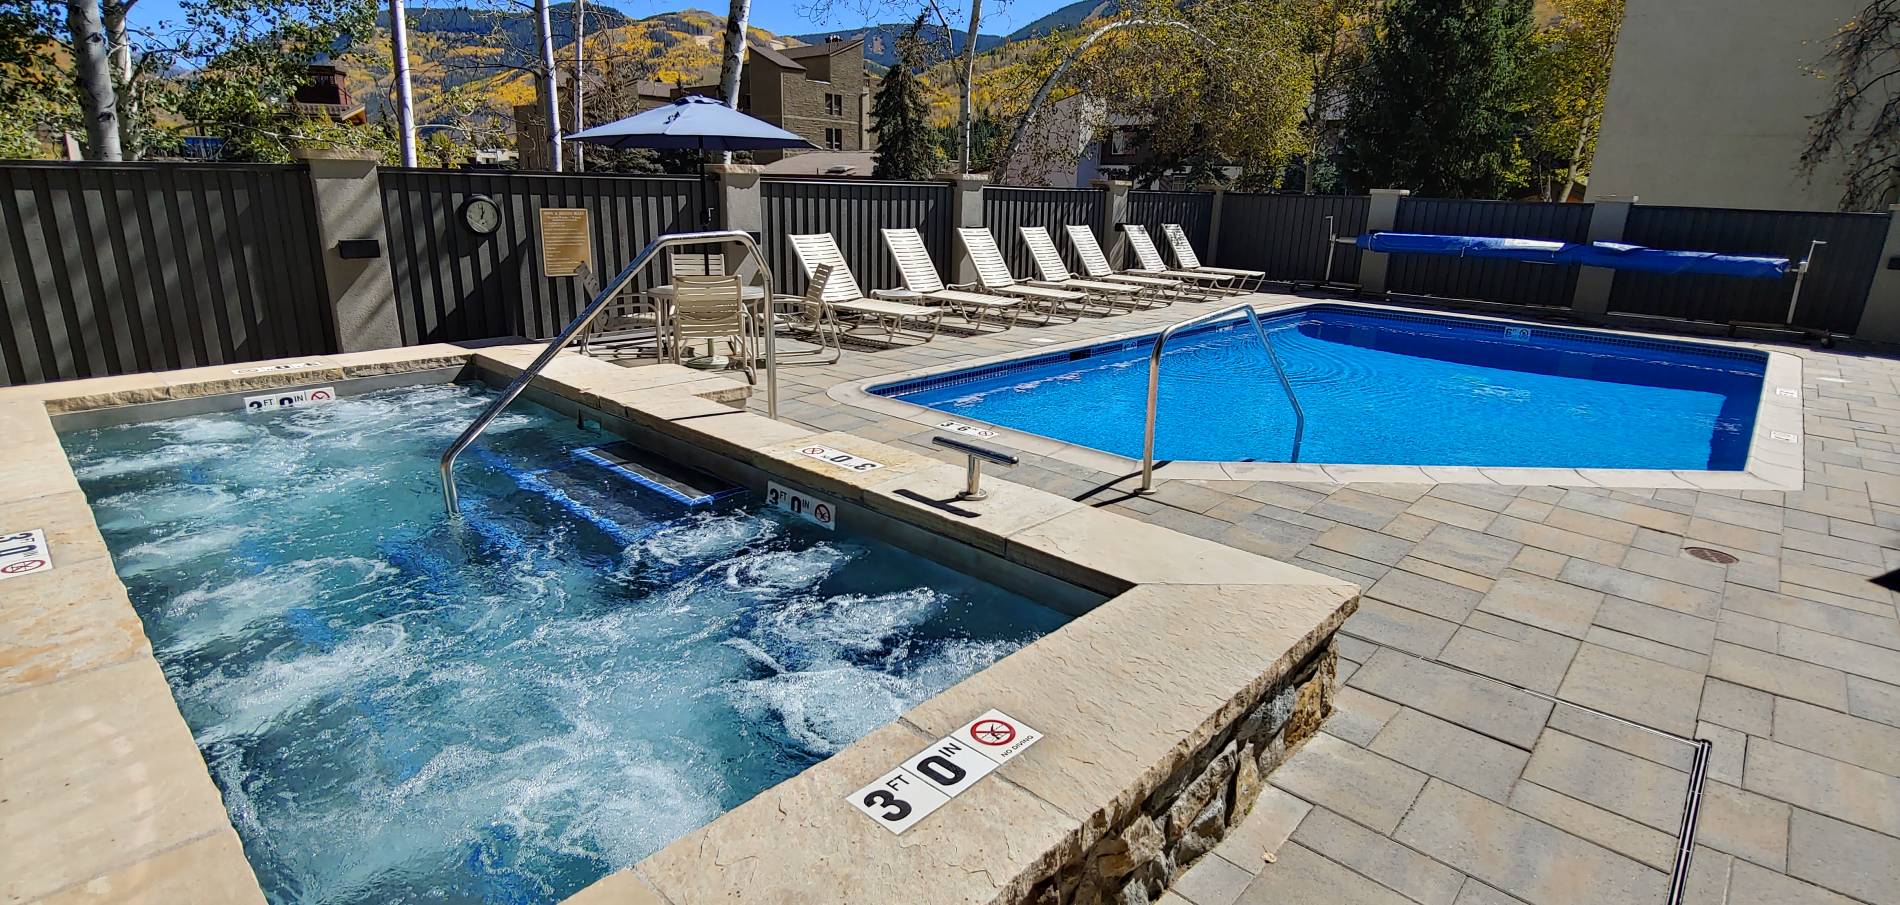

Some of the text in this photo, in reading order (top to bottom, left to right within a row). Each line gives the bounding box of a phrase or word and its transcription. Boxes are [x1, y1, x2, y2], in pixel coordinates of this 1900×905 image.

[829, 455, 853, 463] 0
[854, 463, 876, 471] 3
[769, 488, 809, 513] 3 FT 0 IN
[1000, 735, 1033, 758] NO DIVING
[863, 742, 967, 822] 3 FT 0 IN
